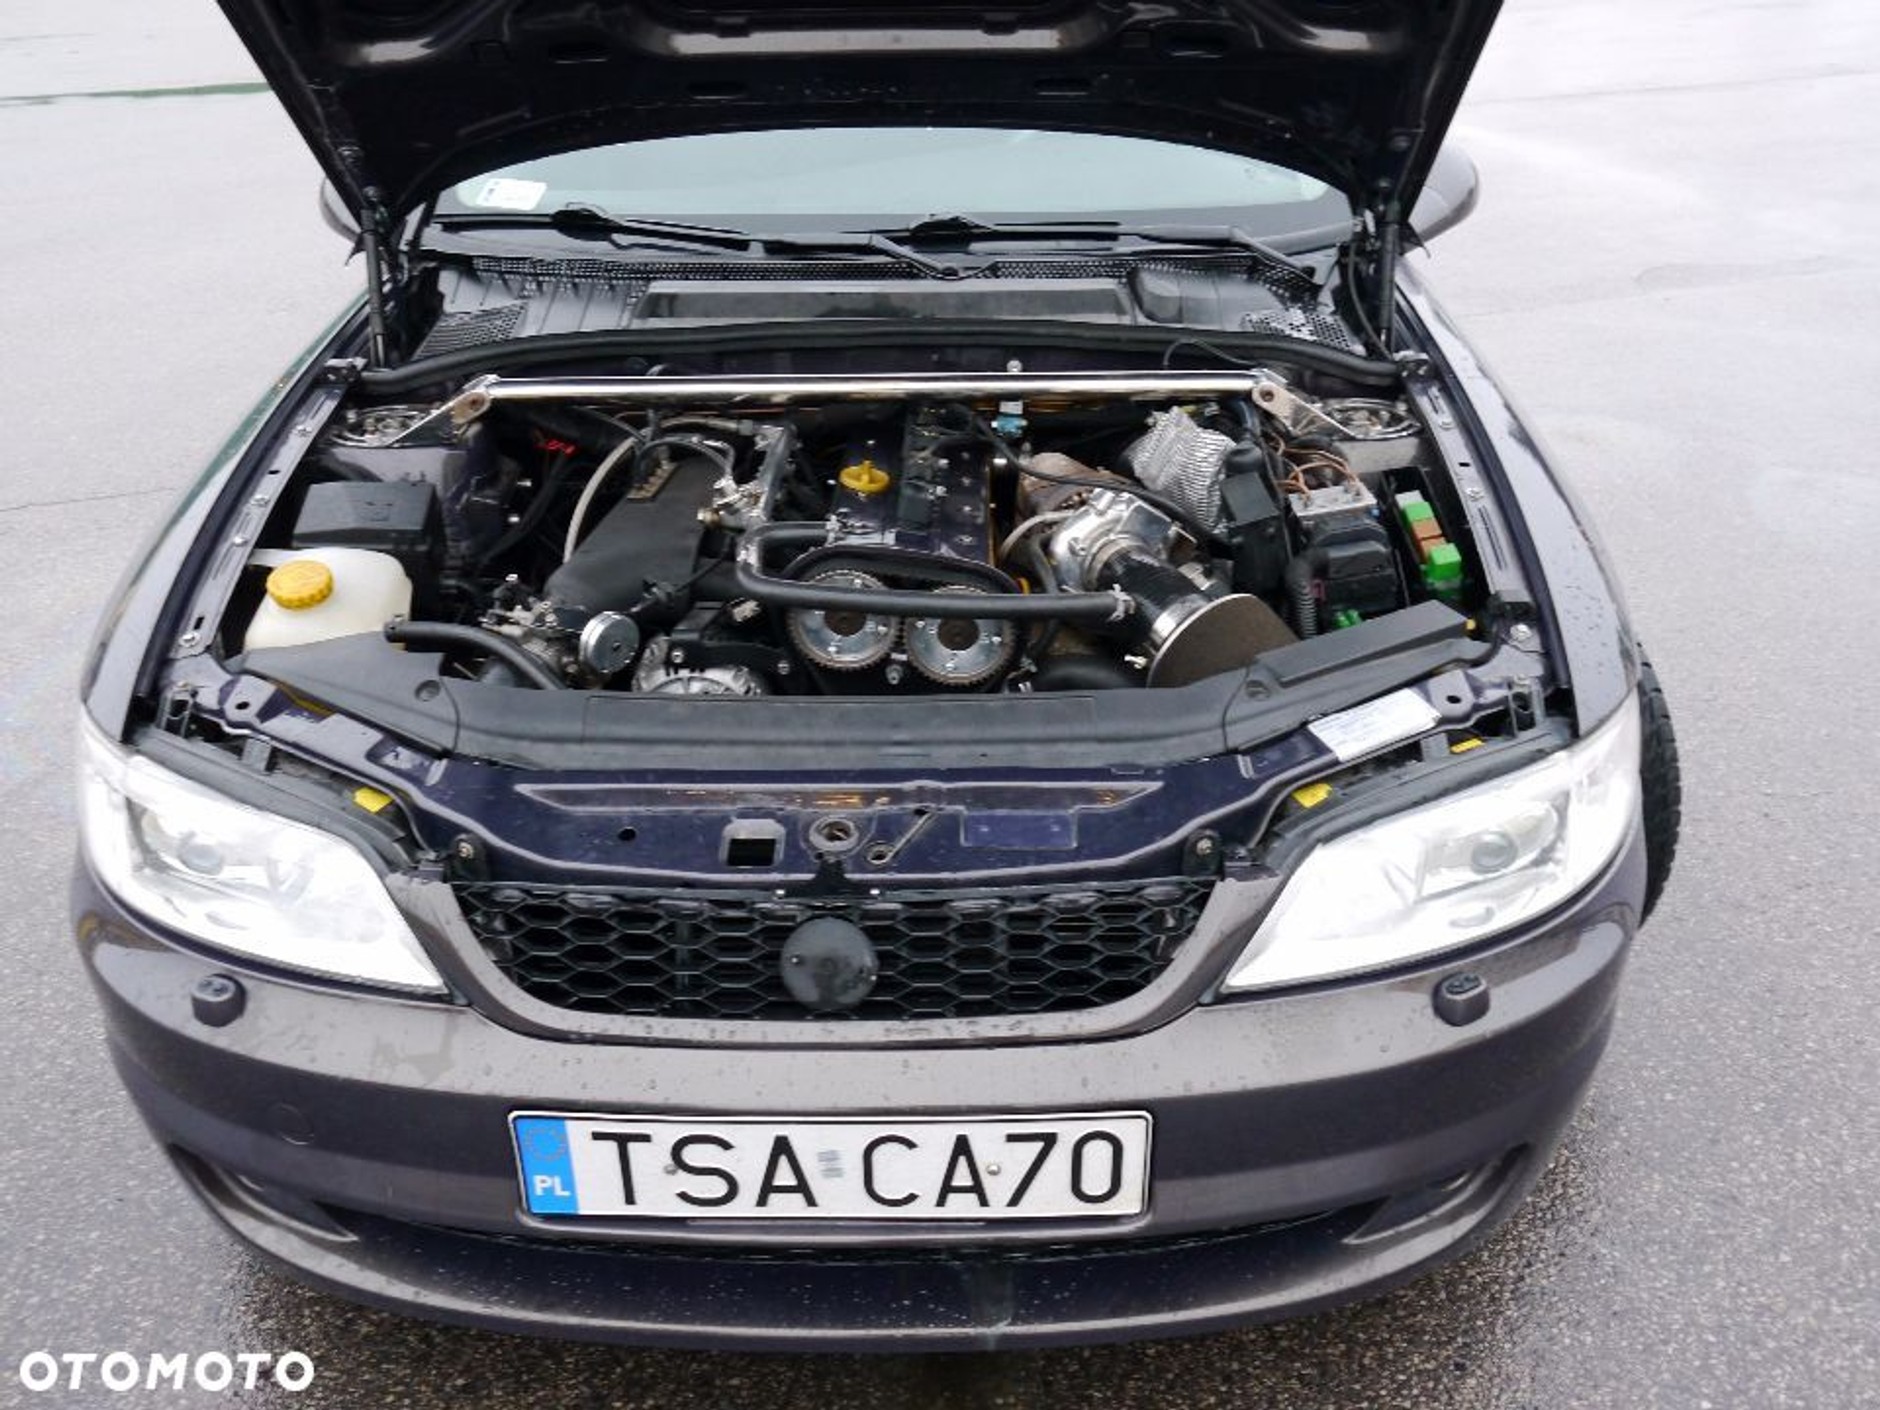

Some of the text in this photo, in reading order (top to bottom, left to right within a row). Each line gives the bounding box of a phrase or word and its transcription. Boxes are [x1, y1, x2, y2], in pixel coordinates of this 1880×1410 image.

[533, 1175, 571, 1197] PL
[591, 1130, 1124, 1208] TSA CA70
